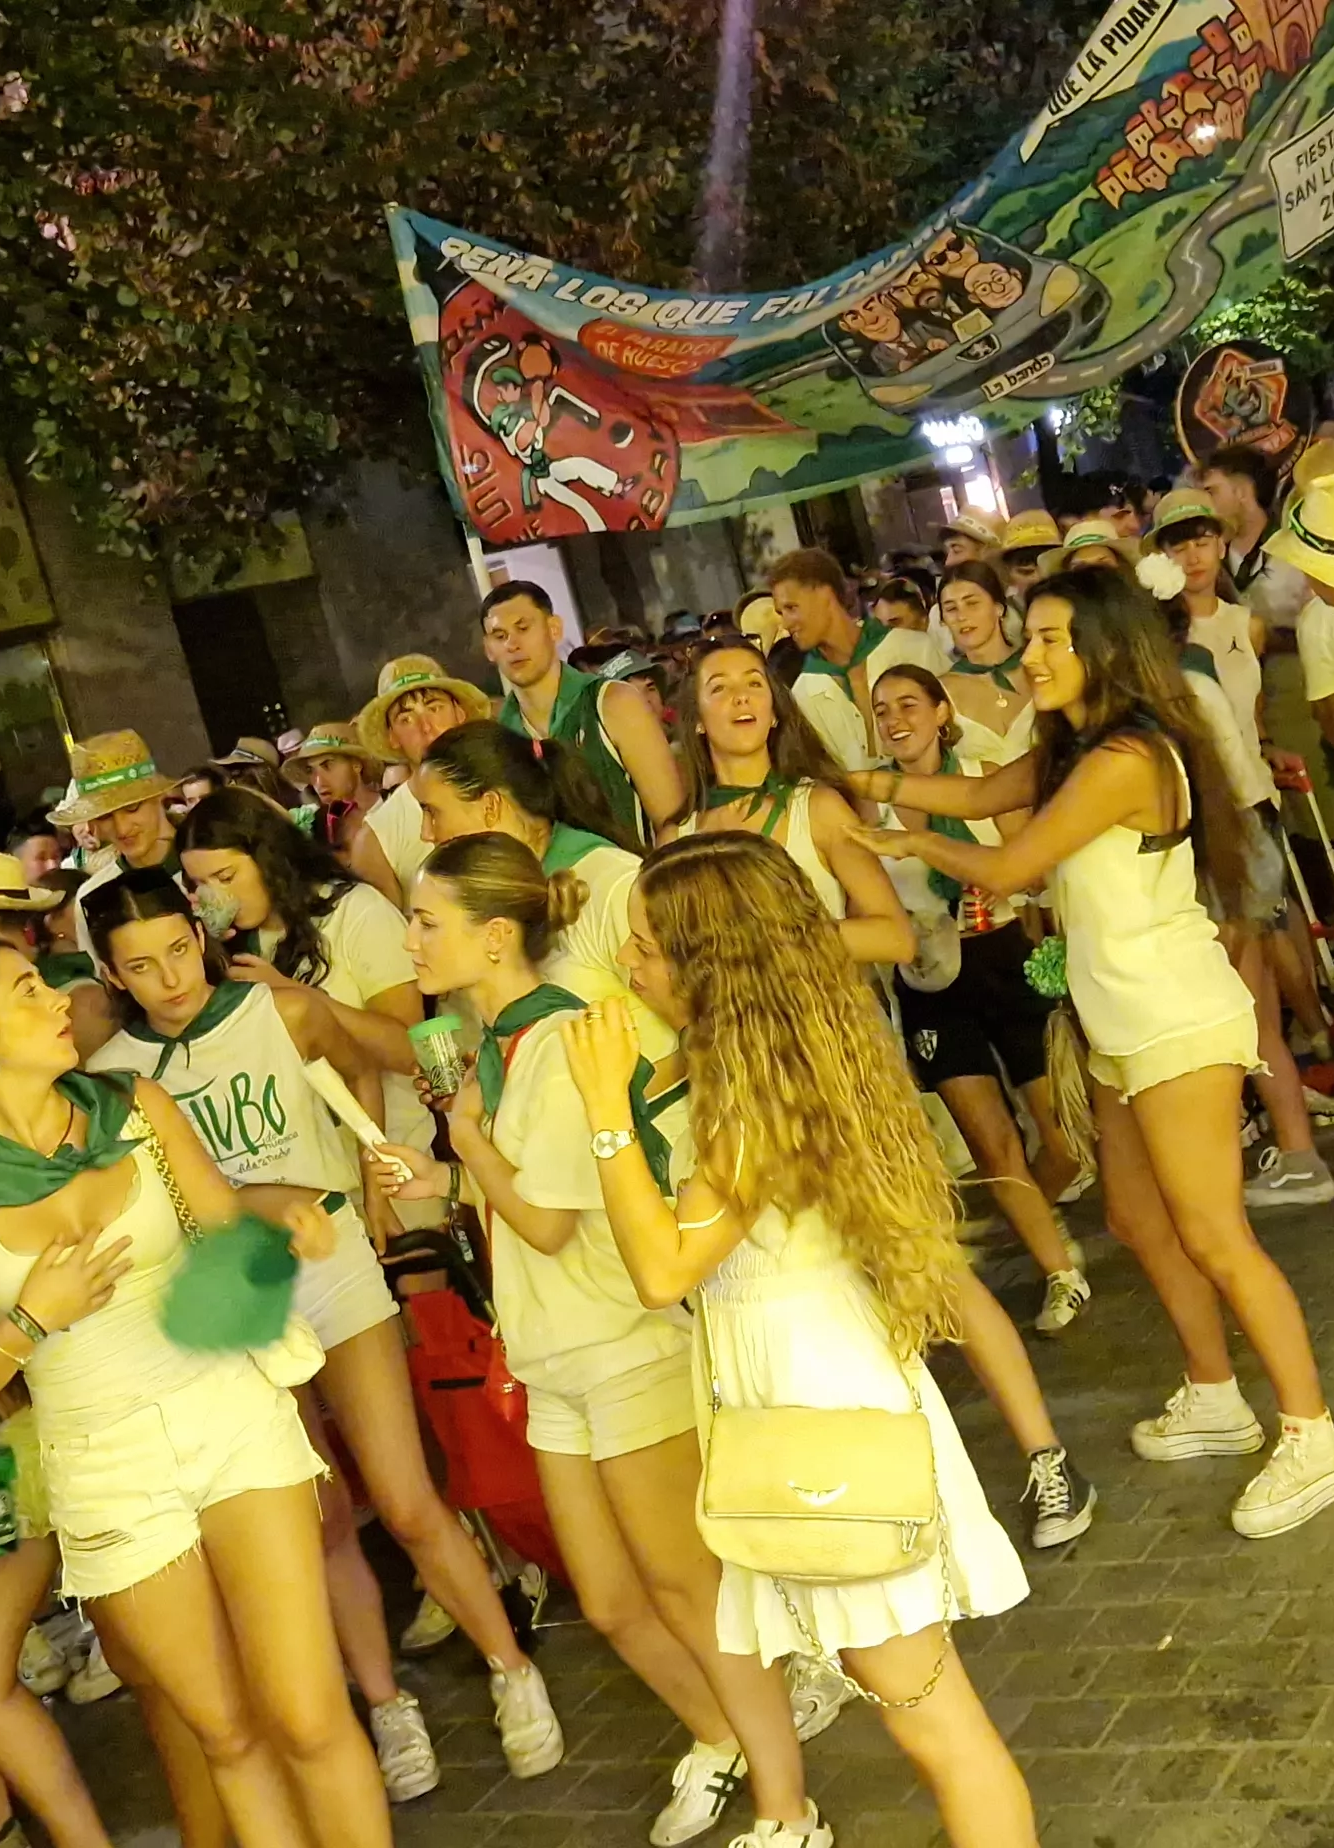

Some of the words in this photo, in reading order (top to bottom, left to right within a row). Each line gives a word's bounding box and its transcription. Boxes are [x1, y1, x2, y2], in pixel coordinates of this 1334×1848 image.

[1075, 49, 1108, 83] LA
[1284, 172, 1318, 213] SAN
[553, 277, 650, 316] LOS
[653, 298, 751, 330] QUE
[597, 340, 621, 364] DE
[983, 382, 1005, 398] La
[1005, 354, 1052, 387] banda
